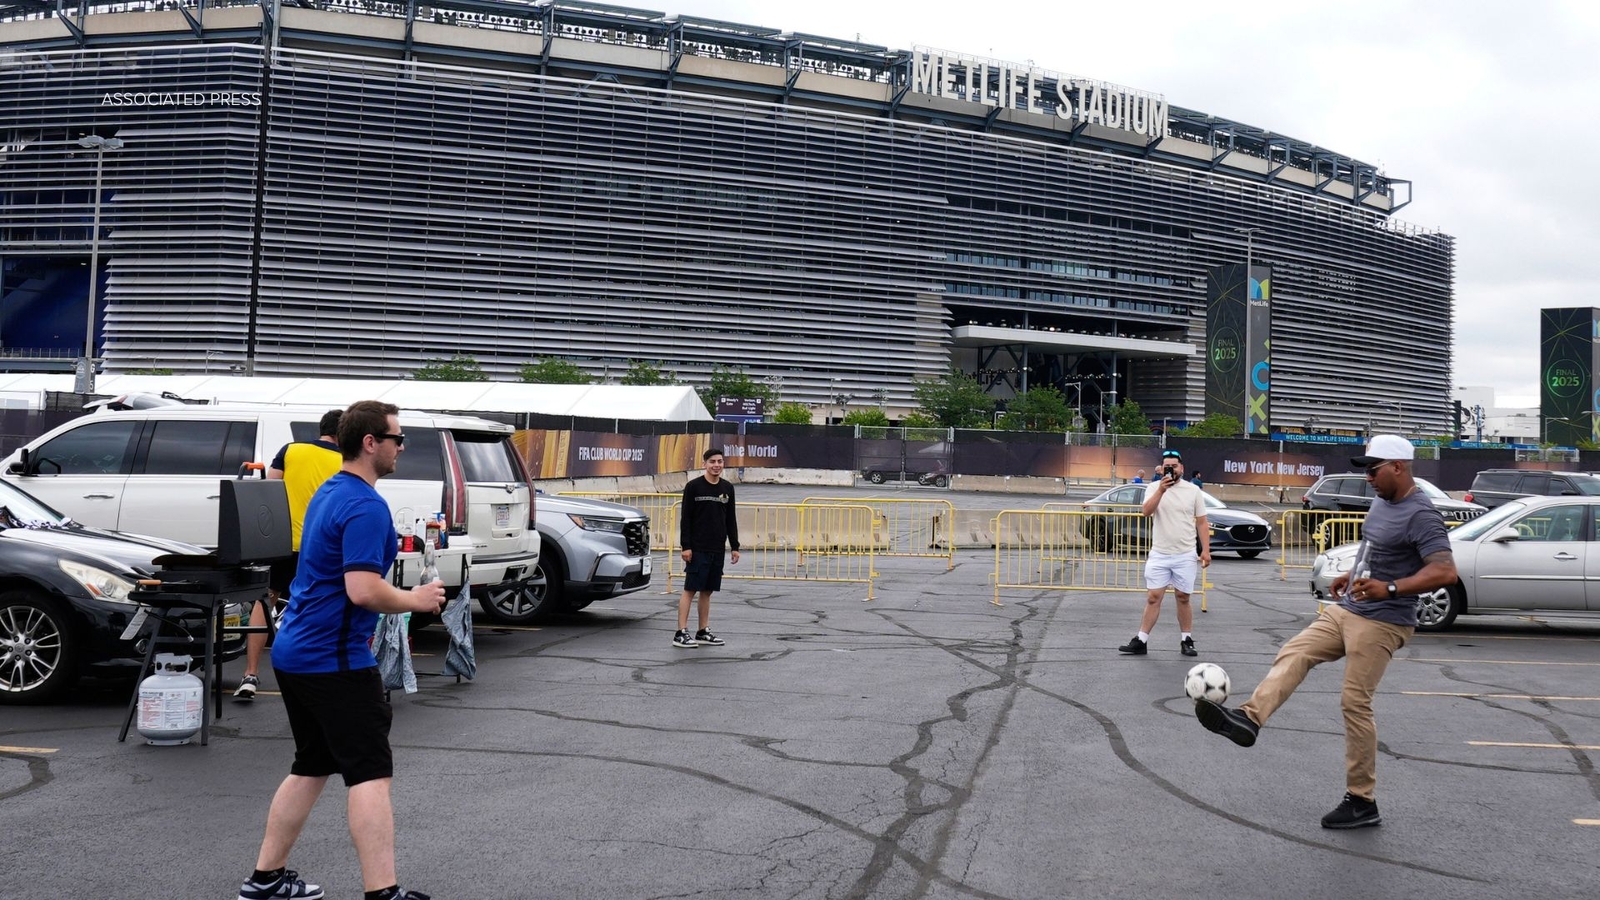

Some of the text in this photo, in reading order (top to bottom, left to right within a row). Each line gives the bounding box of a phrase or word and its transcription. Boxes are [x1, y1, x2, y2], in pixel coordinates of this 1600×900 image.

[911, 50, 1169, 139] METLIFE STADIUM
[1218, 339, 1234, 347] FINAL
[1215, 348, 1236, 360] 2025
[1552, 376, 1580, 387] 2025
[578, 446, 590, 460] FIFA
[591, 447, 603, 460] CLUB
[604, 448, 622, 461] WORLD
[623, 448, 631, 461] CUP
[748, 445, 778, 458] World
[1224, 460, 1324, 477] New York New Jersey
